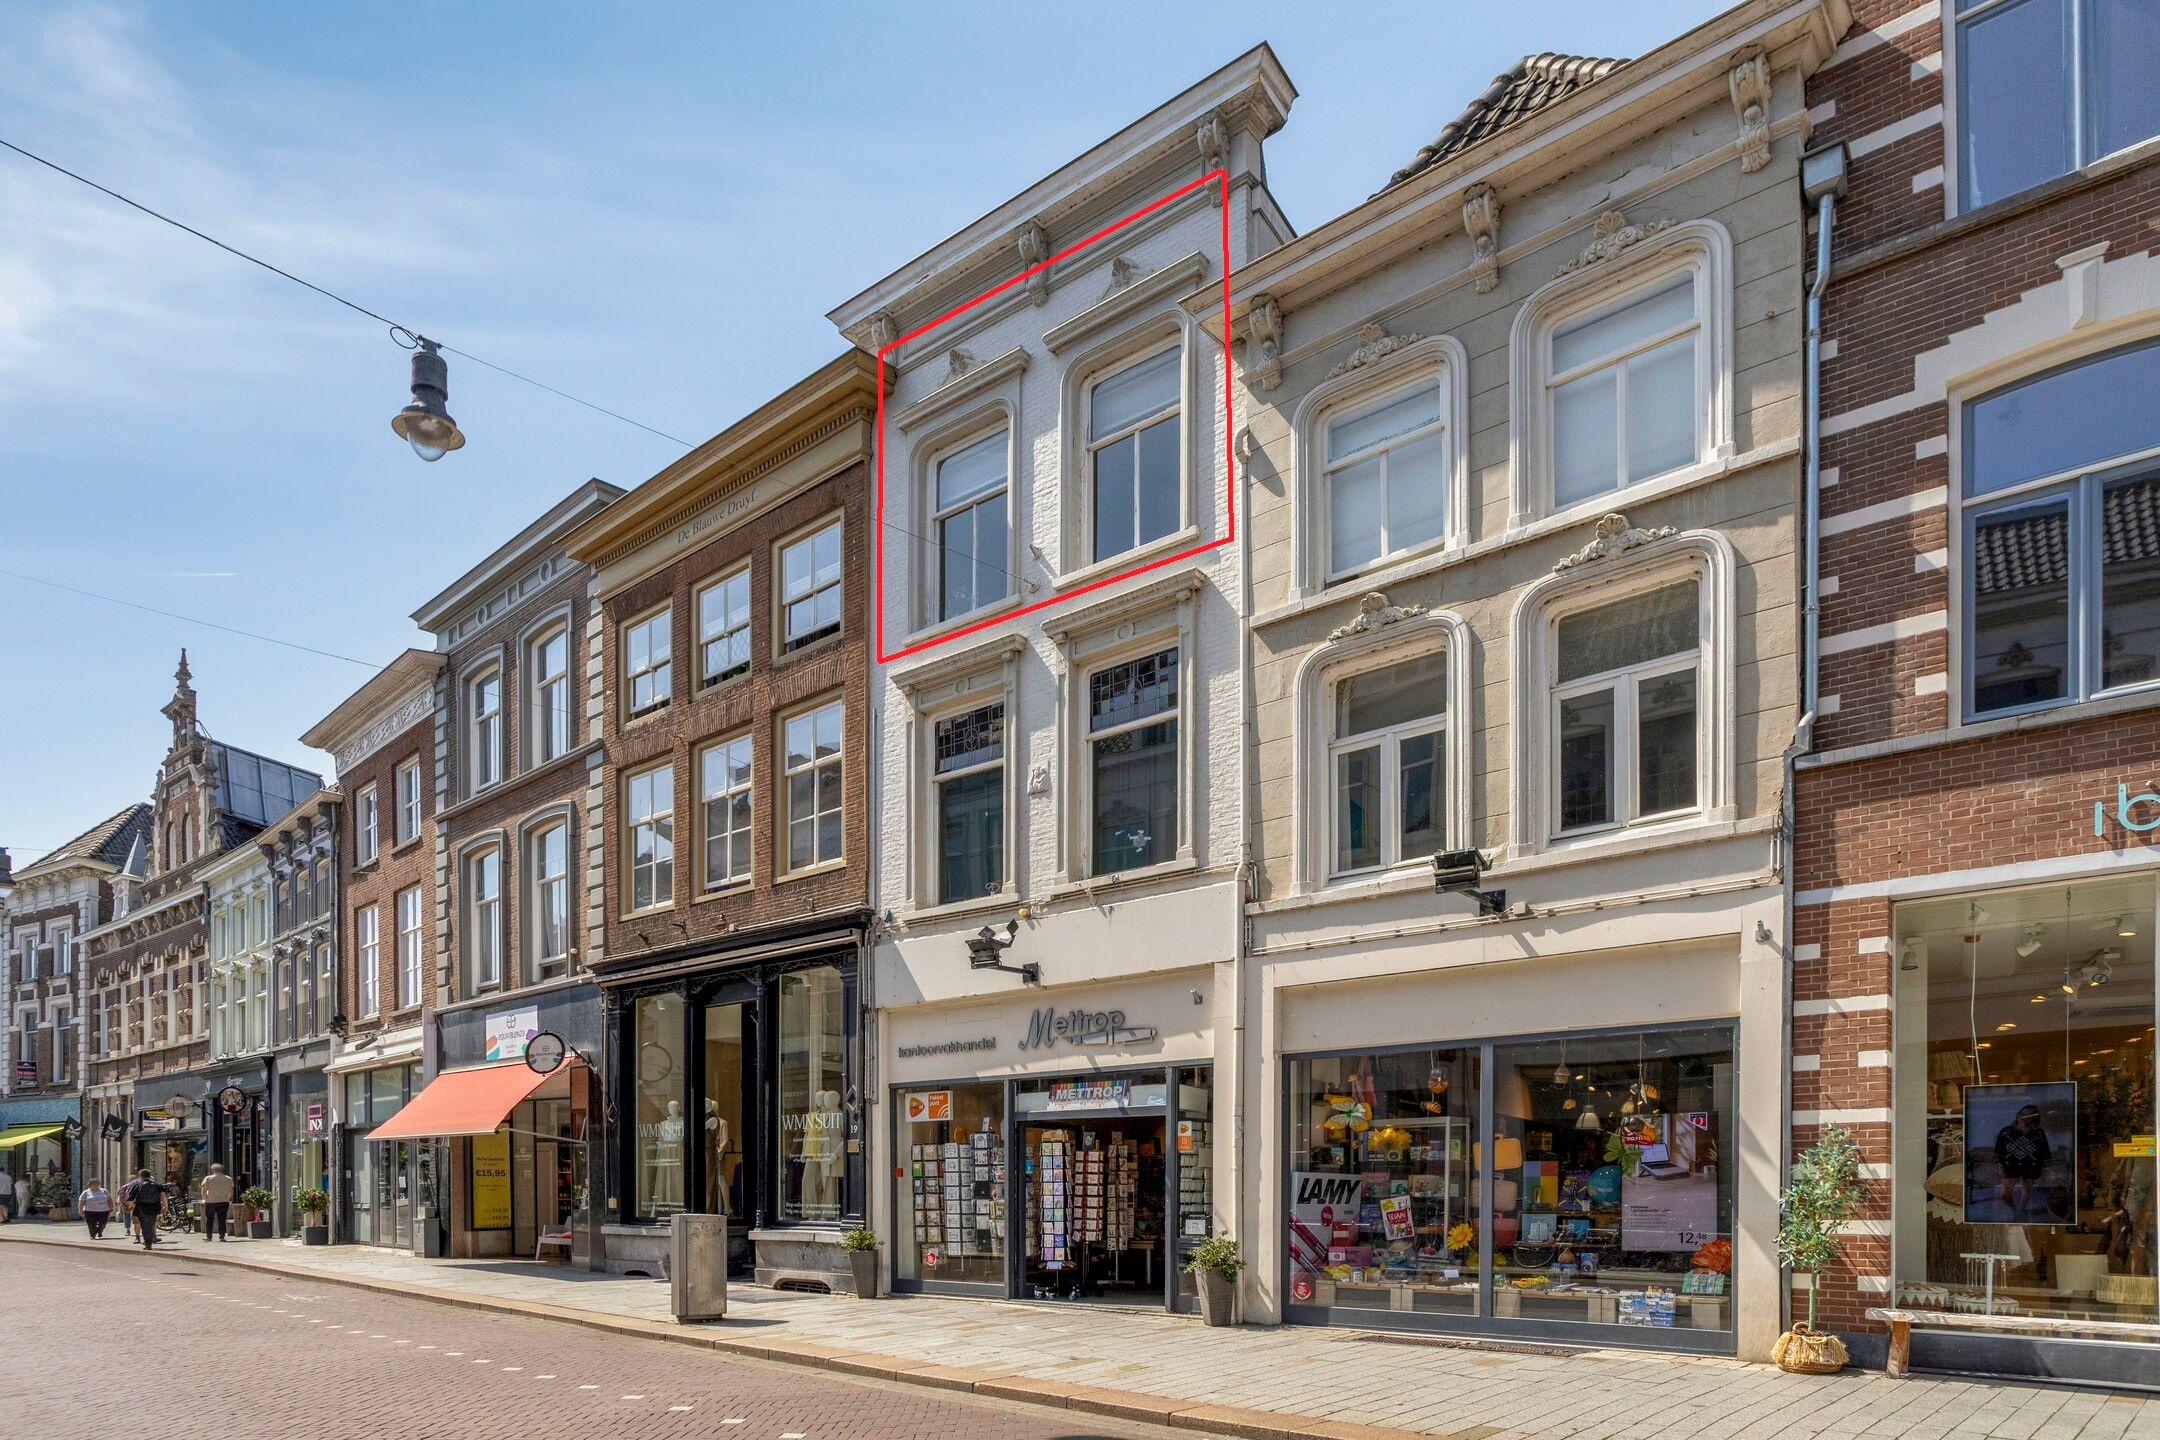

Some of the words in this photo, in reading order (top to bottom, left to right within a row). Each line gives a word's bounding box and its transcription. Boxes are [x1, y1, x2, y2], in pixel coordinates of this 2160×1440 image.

[677, 529, 690, 544] De
[692, 508, 725, 536] Blauwe
[727, 488, 757, 516] Druyf
[1018, 1007, 1125, 1050] Mettrop
[898, 1036, 997, 1058] kantoorvakhandel
[1055, 1085, 1123, 1100] METTROP
[638, 1123, 663, 1138] WMN
[781, 1113, 814, 1131] WMN
[815, 1111, 843, 1129] SUIT
[850, 1125, 858, 1134] 19
[475, 1169, 506, 1178] €15,95
[1296, 1177, 1362, 1205] LAMY
